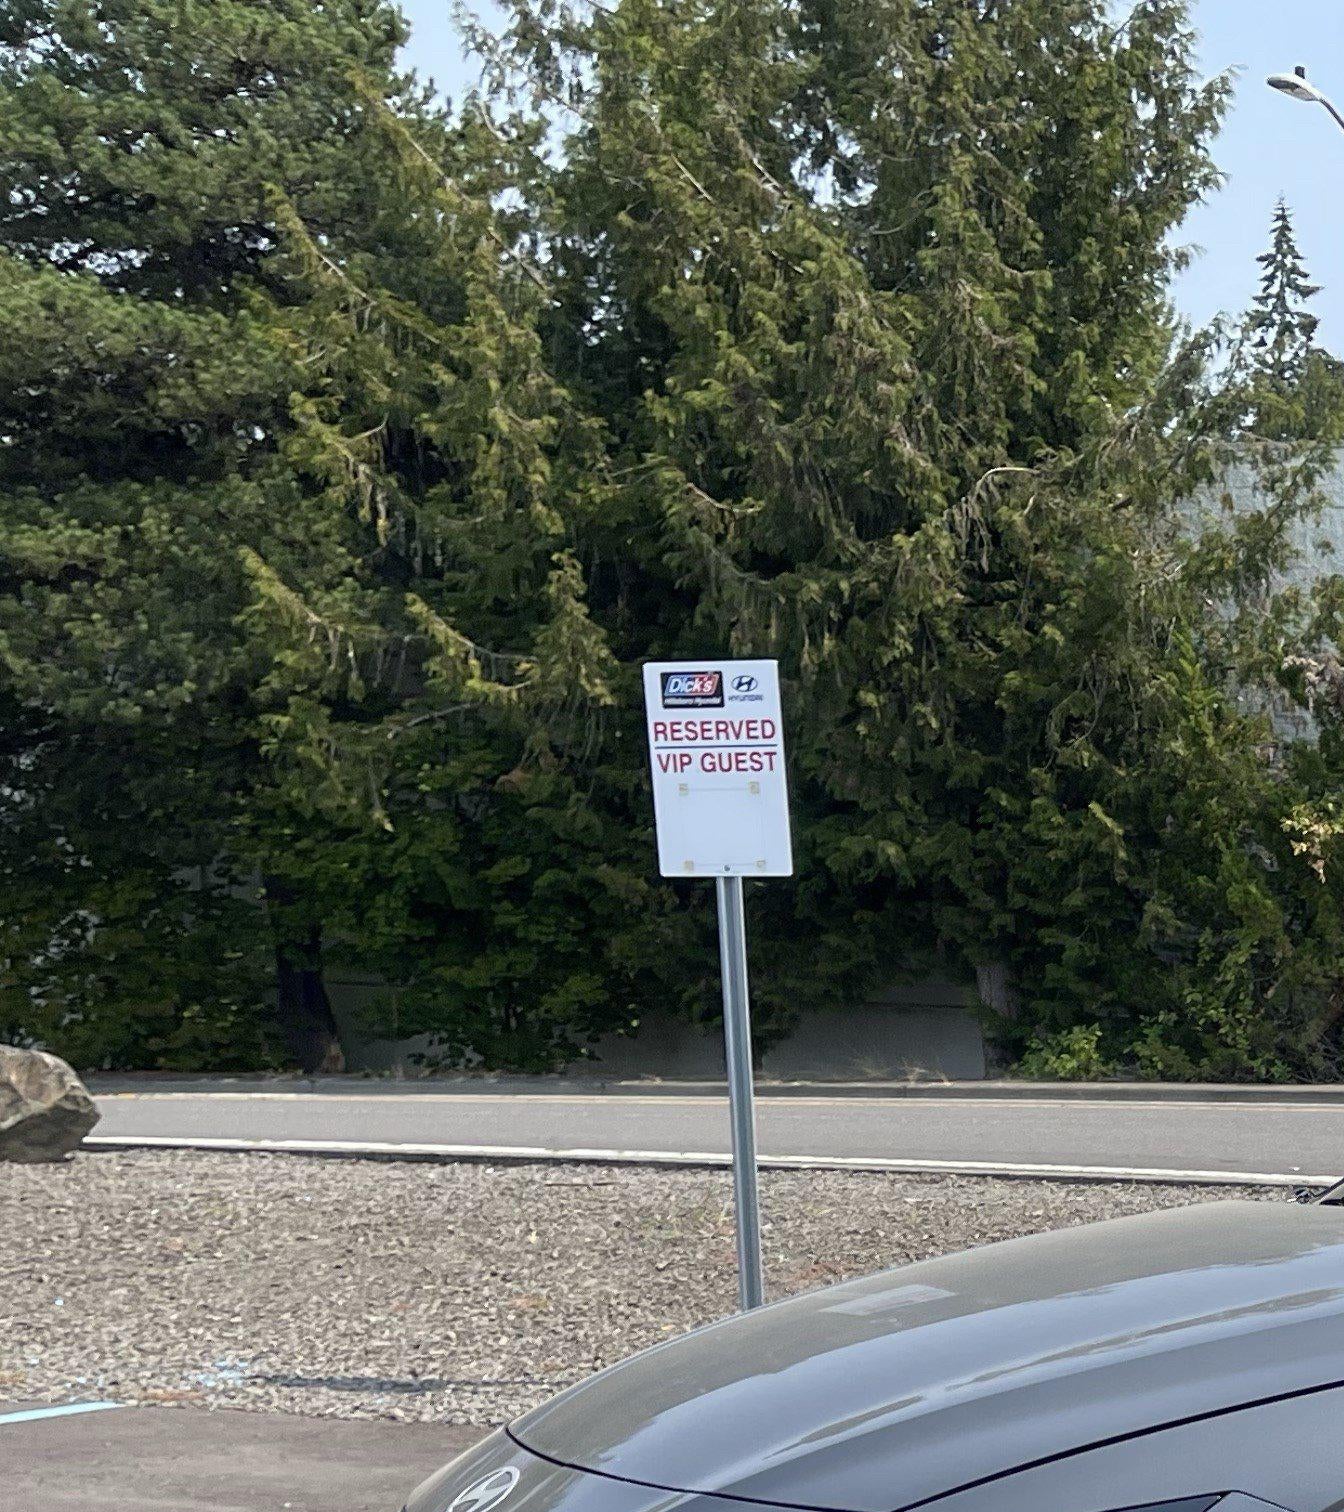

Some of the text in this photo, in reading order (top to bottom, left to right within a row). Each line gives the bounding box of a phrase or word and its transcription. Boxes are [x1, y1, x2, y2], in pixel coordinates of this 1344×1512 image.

[653, 719, 777, 742] RESERVED
[656, 751, 778, 773] VIP GUEST
